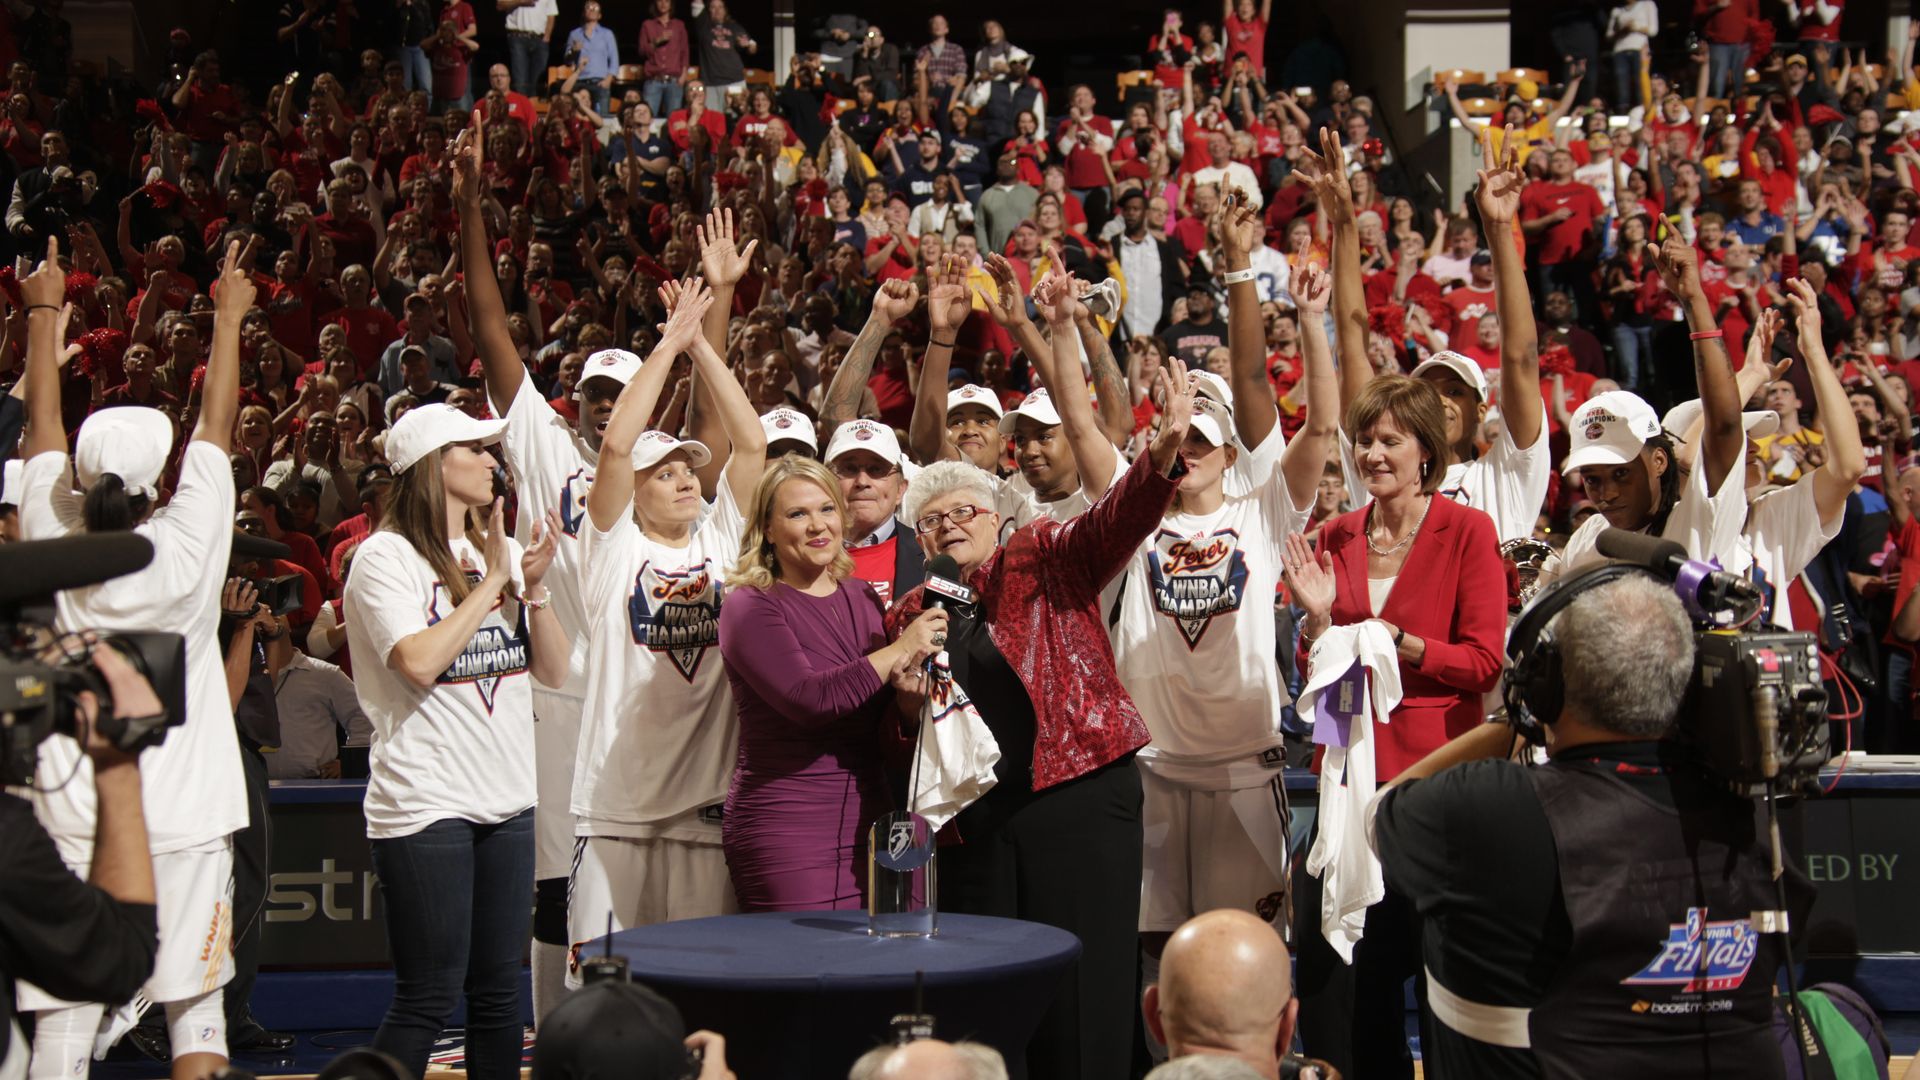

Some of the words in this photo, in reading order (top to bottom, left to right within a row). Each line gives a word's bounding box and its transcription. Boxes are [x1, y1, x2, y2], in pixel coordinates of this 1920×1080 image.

[846, 423, 882, 434] CHAMPIONS
[1163, 539, 1229, 575] Fever
[930, 575, 970, 599] ESPN
[1172, 577, 1220, 599] WNBA
[1155, 585, 1237, 617] CHAMPIONS
[664, 605, 711, 626] WNBA
[466, 629, 506, 654] WNBA
[638, 619, 721, 645] CHAMPION
[1804, 854, 1851, 881] ED
[1859, 853, 1899, 881] BY
